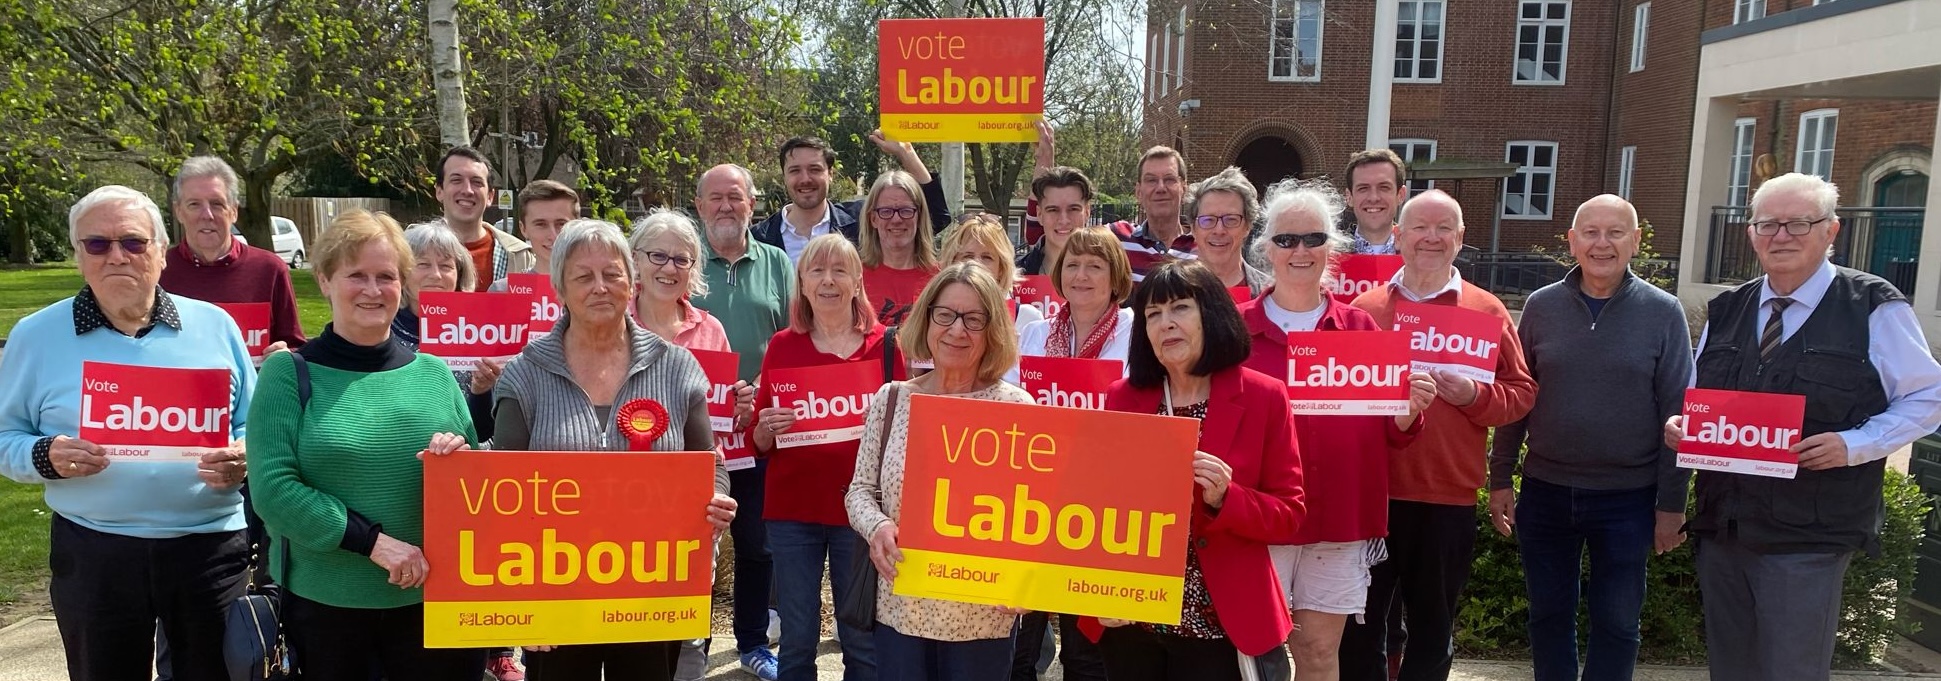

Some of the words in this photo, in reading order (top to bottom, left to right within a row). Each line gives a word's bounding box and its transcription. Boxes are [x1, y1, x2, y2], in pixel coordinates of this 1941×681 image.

[898, 31, 965, 60] vote
[898, 67, 1037, 105] Labour
[906, 121, 940, 130] Labour
[978, 121, 1035, 131] labour.org.uk
[509, 285, 533, 295] Vote
[1015, 286, 1037, 295] Vote
[421, 304, 448, 316] Vote
[1396, 312, 1421, 324] Vote
[420, 316, 529, 345] Labour
[1393, 324, 1498, 360] abour
[1289, 345, 1318, 356] Vote
[1021, 368, 1043, 380] Vote
[1288, 357, 1409, 387] Labour
[84, 378, 119, 393] Vote
[771, 382, 797, 393] Vote
[1021, 382, 1108, 411] abou
[82, 394, 228, 433] Labour
[1313, 402, 1343, 410] Labour
[1685, 402, 1711, 413] Vote
[778, 435, 795, 444] Vote
[1681, 414, 1799, 450] Labour
[113, 447, 151, 457] Labour
[941, 422, 1057, 472] vote
[1678, 456, 1696, 464] Vote
[459, 470, 581, 516] vote
[932, 477, 1176, 558] Labour
[459, 528, 700, 587] Labour
[942, 563, 1001, 584] Labour
[1067, 578, 1168, 602] labour.org.uk
[474, 612, 535, 626] Labour
[602, 607, 698, 624] labour.org.uk
